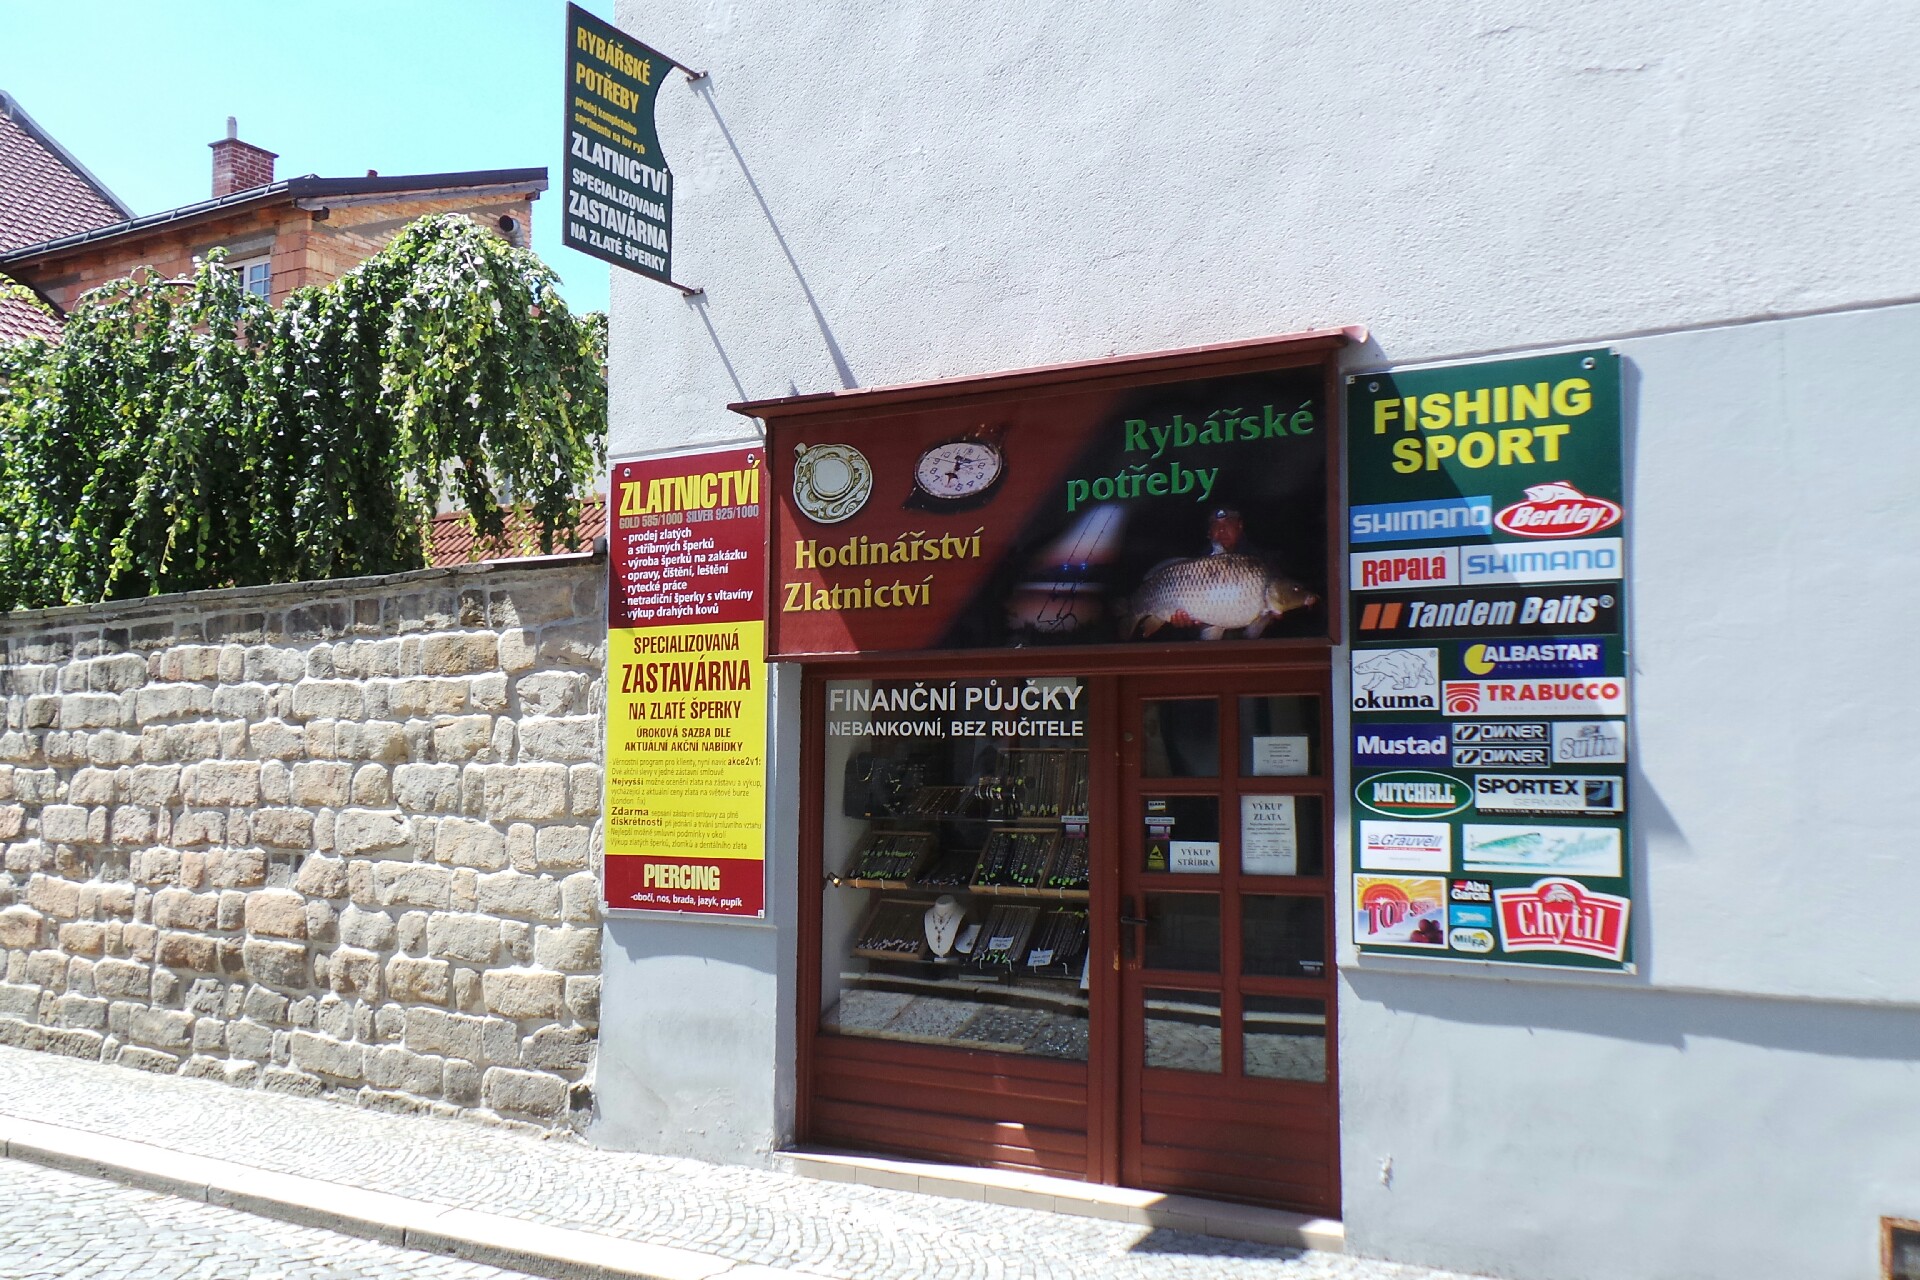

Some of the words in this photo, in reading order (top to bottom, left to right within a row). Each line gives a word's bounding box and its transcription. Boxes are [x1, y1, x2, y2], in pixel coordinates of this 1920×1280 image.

[577, 26, 650, 86] RYBÁŘSKÉ
[575, 62, 639, 114] POTŘEBY
[575, 96, 597, 117] prodej
[612, 132, 621, 144] na
[571, 131, 668, 196] ZLATNICTVÍ
[572, 168, 666, 223] SPECIALIZOVANÁ
[569, 190, 669, 253] ZASTAVÁRNA
[570, 221, 588, 243] NA
[589, 229, 623, 256] ZLATÉ
[624, 240, 666, 272] ŠPERKY
[1374, 378, 1592, 435] FISHING
[1124, 400, 1314, 460] Rybářské
[1392, 424, 1570, 474] SPORT
[619, 460, 760, 516] ZLATNICTVÍ
[1066, 461, 1219, 513] potřeby
[619, 517, 640, 529] GOLD
[642, 512, 683, 527] 585/1000
[686, 510, 713, 523] SILVER
[716, 505, 759, 520] 925/1000
[1353, 505, 1491, 534] SHIMANO
[1510, 503, 1607, 529] Berkley
[628, 530, 658, 544] prodej
[660, 527, 692, 543] zlatých
[628, 547, 634, 555] a
[635, 542, 681, 557] stříbrných
[683, 538, 714, 553] šperků
[795, 526, 985, 570] Hodinářství
[628, 556, 659, 570] výroba
[661, 551, 691, 567] šperků
[694, 554, 706, 563] na
[708, 549, 747, 561] zakázku
[1467, 548, 1614, 575] SHIMANO
[627, 570, 661, 582] opravy,
[663, 566, 695, 578] čištění,
[697, 563, 729, 576] leštění
[627, 581, 660, 595] rytecké
[662, 580, 688, 593] práce
[627, 593, 672, 606] netradiční
[674, 590, 705, 604] šperky
[714, 588, 753, 604] vltavíny
[783, 574, 934, 612] Zlatnictví
[627, 607, 655, 620] výkup
[656, 604, 693, 618] drahých
[695, 602, 719, 615] kovů
[1408, 600, 1517, 628] Tandem
[634, 628, 739, 654] SPECIALIZOVANÁ
[1483, 644, 1599, 662] ALBASTAR
[621, 654, 751, 693] ZASTAVÁRNA
[830, 681, 956, 711] FINANČNÍ
[965, 679, 1084, 711] PŮJČKY
[1353, 690, 1434, 709] okuma
[1486, 683, 1620, 701] TRABUCCO
[629, 703, 645, 720] NA
[650, 697, 686, 720] ZLATÉ
[690, 697, 741, 719] ŠPERKY
[637, 726, 678, 738] ÚROKOVÁ
[682, 728, 711, 738] SAZBA
[714, 728, 731, 738] DLE
[829, 717, 945, 739] NEBANKOVNÍ,
[951, 720, 986, 736] BEZ
[991, 717, 1084, 736] RUČITELE
[1481, 725, 1545, 738] OWNER
[624, 740, 668, 752] AKTUÁLNÍ
[671, 740, 699, 752] AKČNÍ
[701, 740, 743, 752] NABÍDKY
[1357, 736, 1447, 755] Mustad
[1481, 749, 1545, 762] OWNER
[640, 760, 663, 768] program
[664, 760, 675, 768] pro
[670, 790, 683, 798] ceny
[684, 788, 699, 796] zlata
[1373, 782, 1456, 804] MITCHELL
[1478, 778, 1580, 795] SPORTEX
[611, 806, 649, 816] Zdarma
[1252, 801, 1283, 810] VÝKUP
[1253, 813, 1282, 821] ZLATA
[1181, 846, 1211, 856] VÝKUP
[1381, 833, 1443, 848] Grauvell
[1177, 857, 1215, 867] STŘÍBRA
[643, 863, 720, 891] PIERCING
[656, 894, 671, 904] nos,
[672, 894, 696, 905] brada,
[697, 895, 719, 907] jazyk,
[1363, 900, 1408, 936] TOP
[1517, 901, 1605, 945] Chytil
